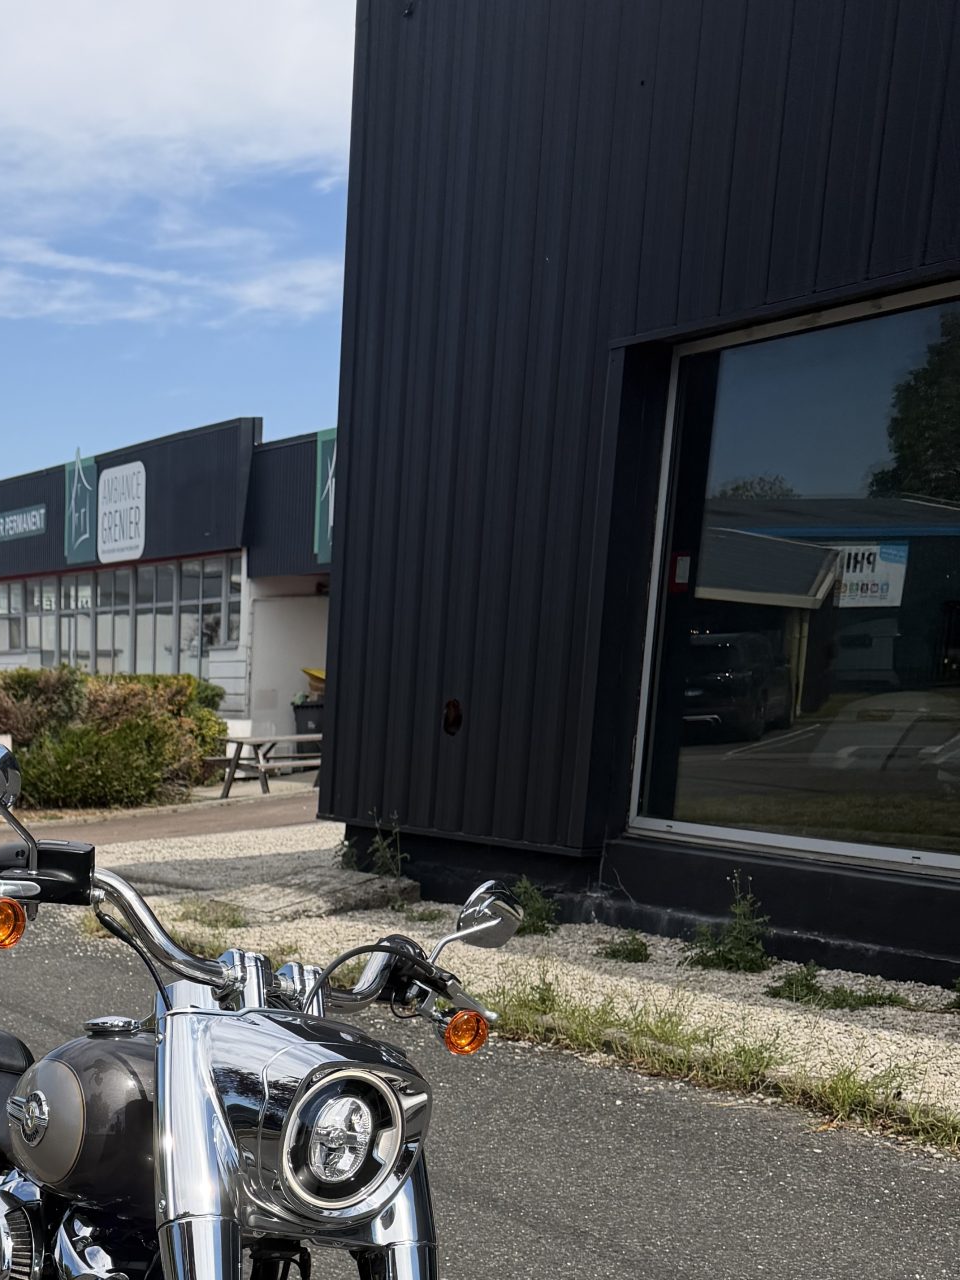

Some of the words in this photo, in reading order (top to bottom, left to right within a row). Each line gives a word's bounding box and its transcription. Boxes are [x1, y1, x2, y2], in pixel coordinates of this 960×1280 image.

[102, 470, 142, 505] AMBIANCE
[5, 508, 46, 536] PERMANENT
[102, 505, 141, 544] GRENIER
